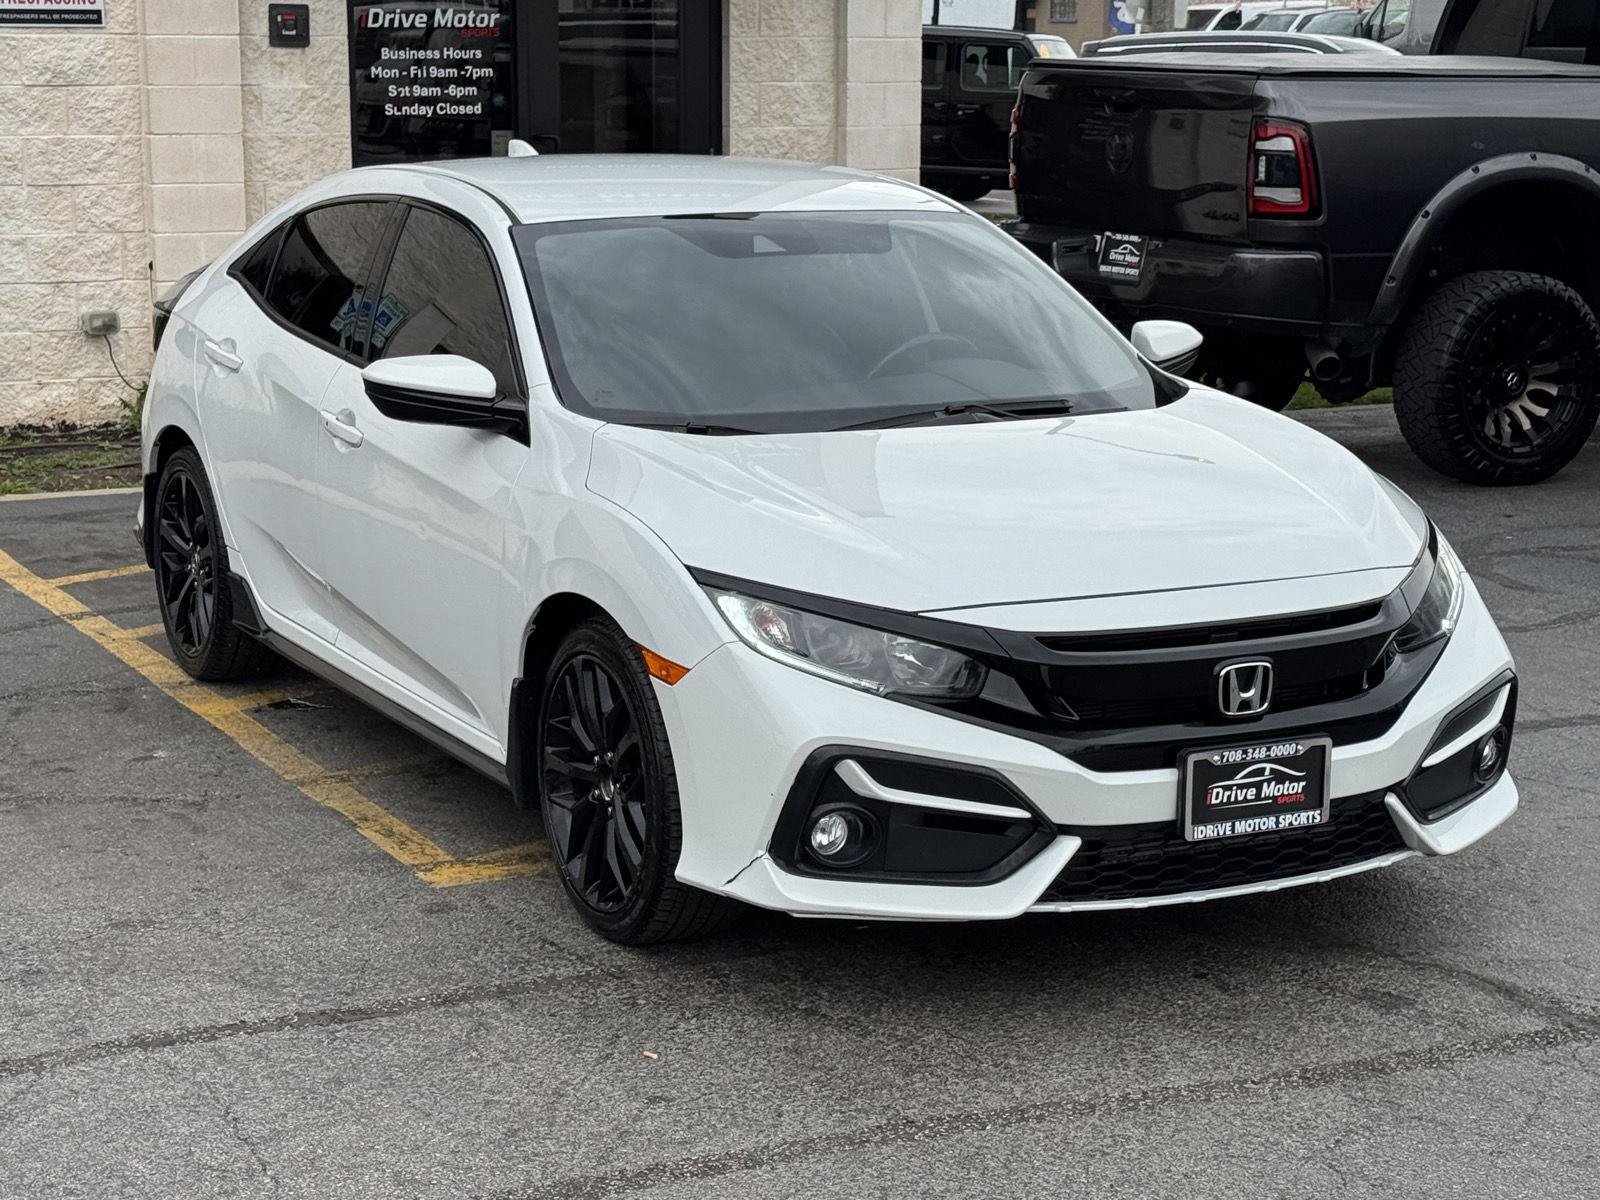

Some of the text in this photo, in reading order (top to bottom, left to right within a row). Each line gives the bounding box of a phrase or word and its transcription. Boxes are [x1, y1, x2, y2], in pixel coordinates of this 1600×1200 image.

[433, 8, 500, 28] Motor
[381, 47, 482, 60] Business Hours
[370, 66, 399, 78] Mon
[429, 65, 458, 78] 9am
[412, 84, 441, 97] 9am
[436, 102, 482, 114] Closed
[1222, 743, 1297, 763] 708-348-0000
[1206, 780, 1307, 806] iDrive Motor
[1277, 795, 1306, 805] SPORTS
[1234, 816, 1276, 834] MOTOR
[1279, 809, 1322, 828] SPORTS
